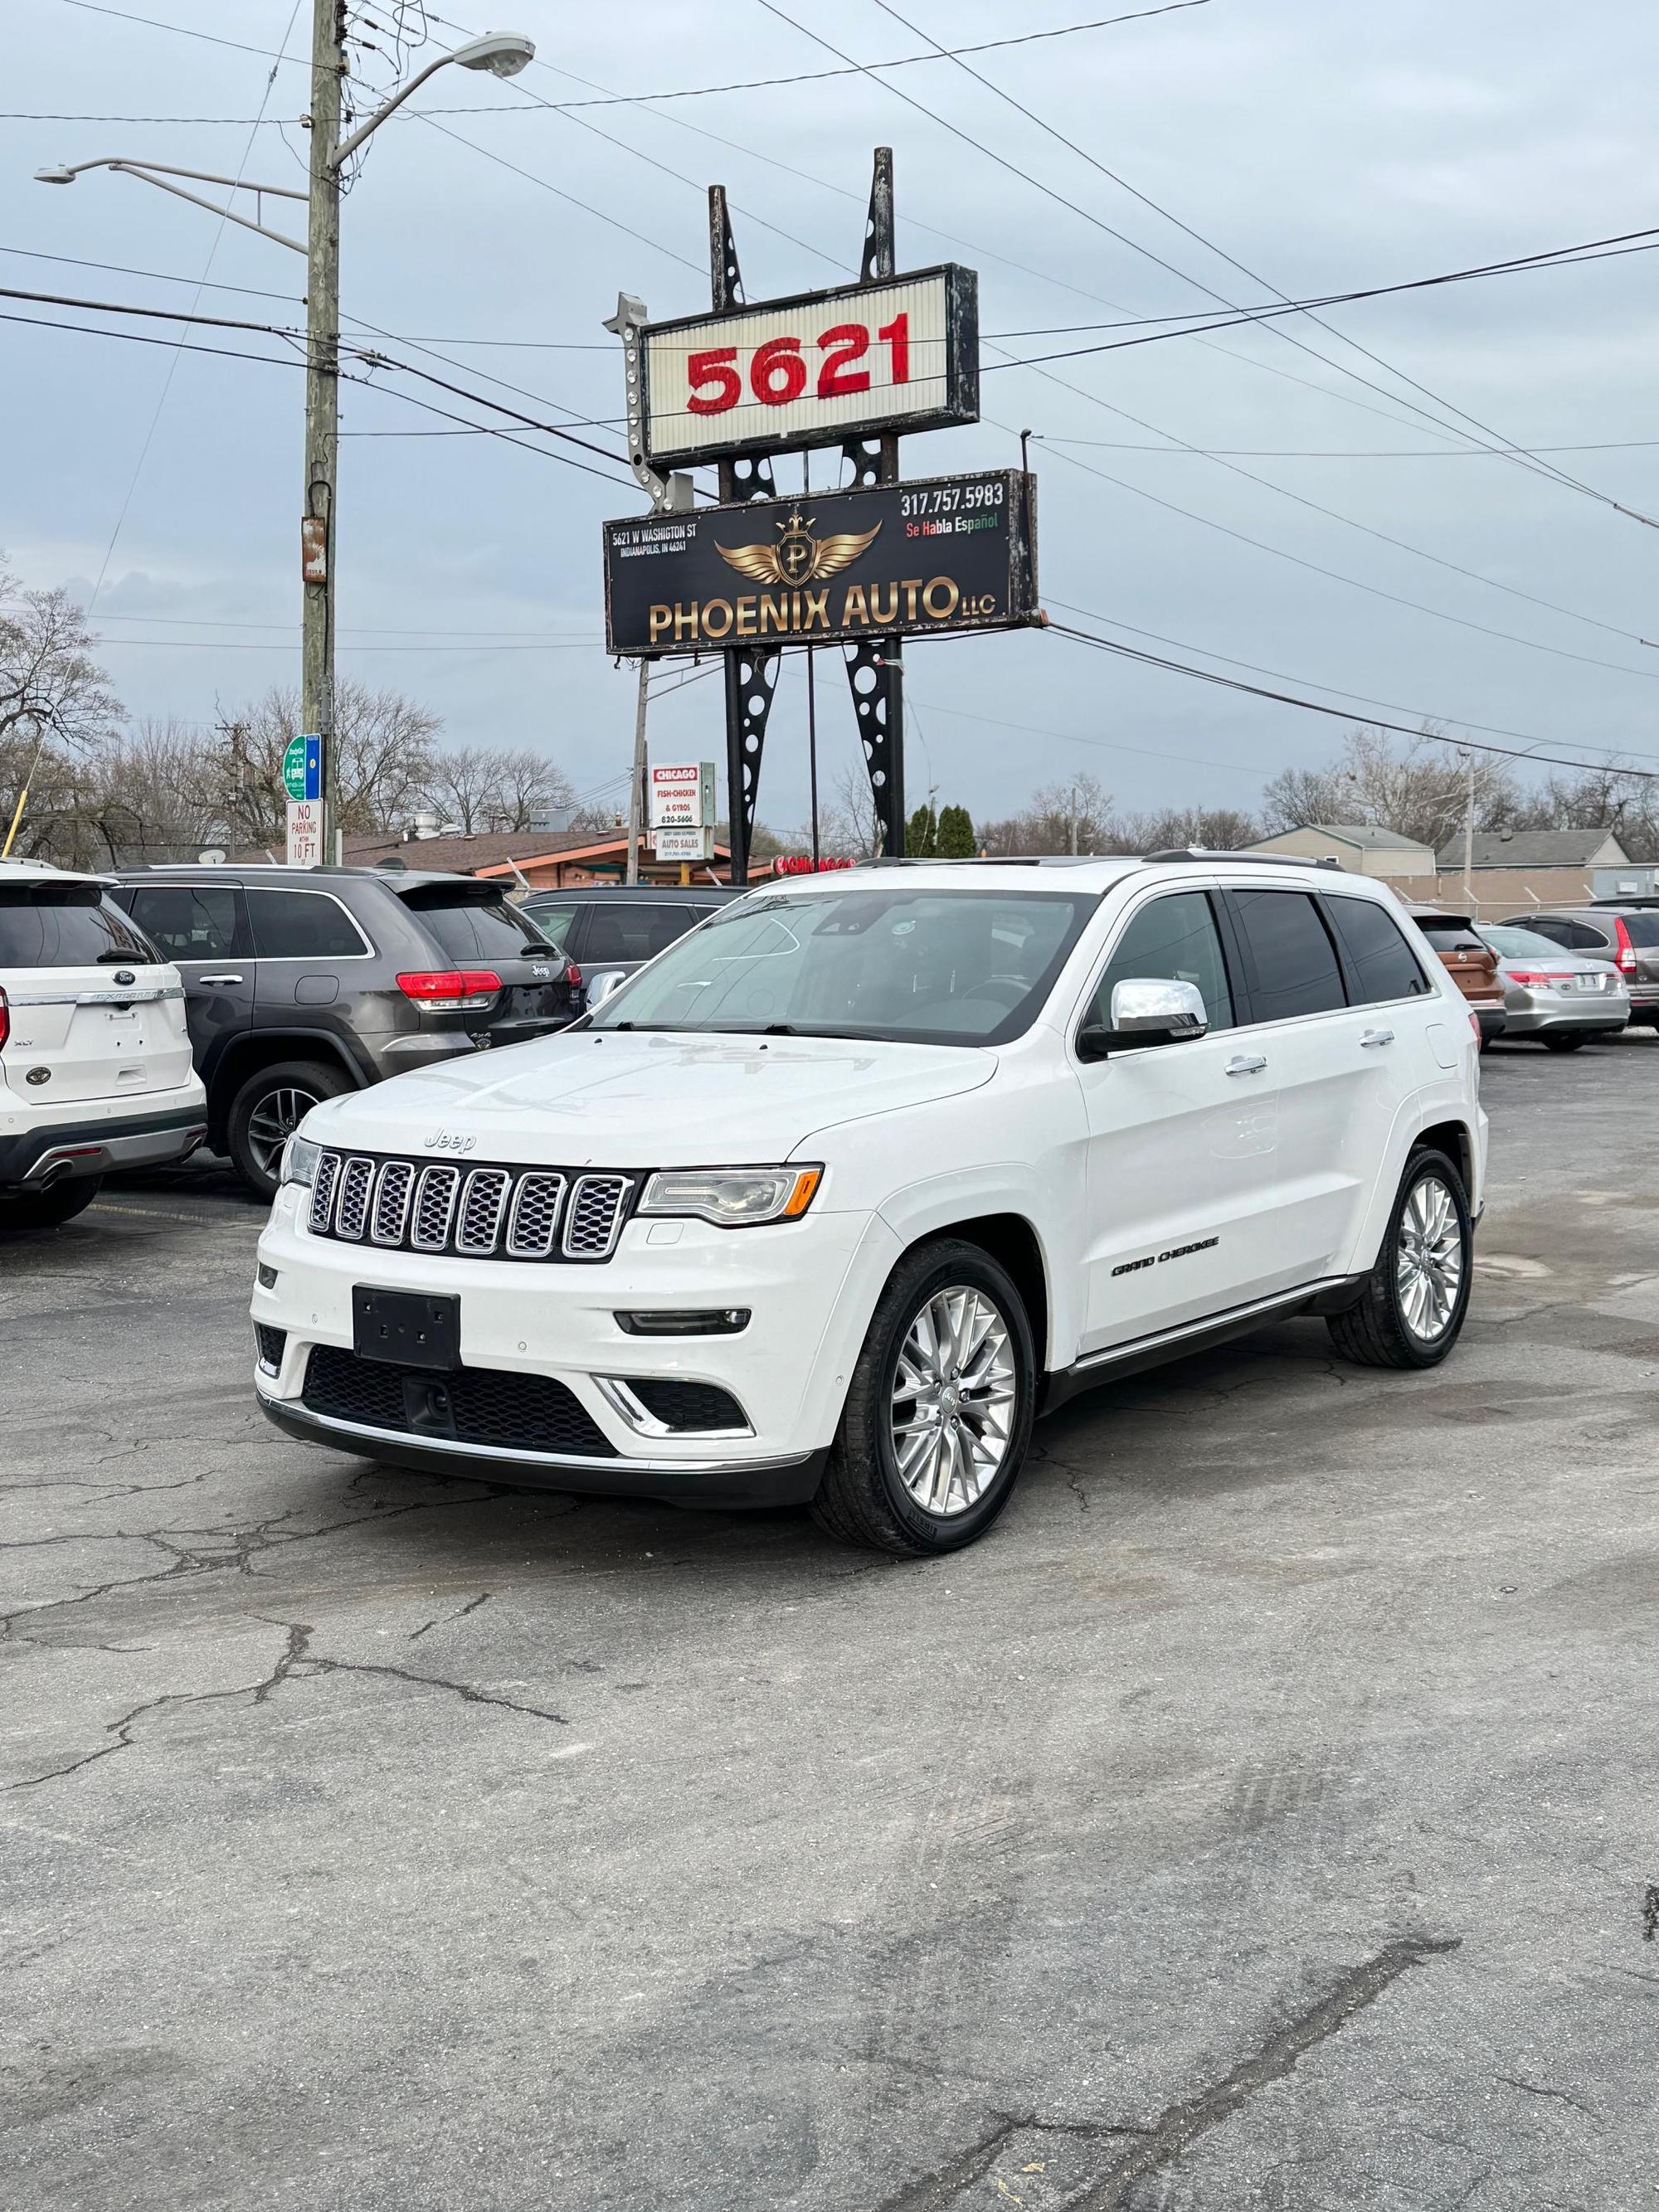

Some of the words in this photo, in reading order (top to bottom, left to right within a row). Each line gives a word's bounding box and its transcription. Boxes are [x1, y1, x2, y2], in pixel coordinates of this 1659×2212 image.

[686, 312, 909, 418] 5621
[901, 483, 1004, 517] 317.757.5983
[907, 523, 919, 537] Se
[922, 518, 952, 536] Habla
[955, 513, 998, 535] Español
[612, 532, 630, 546] 5621
[632, 530, 640, 544] W
[641, 524, 685, 542] WASHIGTON
[687, 523, 697, 537] ST
[662, 542, 669, 553] IN
[669, 541, 686, 552] 46241
[787, 544, 807, 573] P
[649, 588, 830, 643] PHOENIX
[842, 576, 960, 626] AUTO
[962, 593, 996, 616] LLC
[656, 770, 696, 780] CHICAGO
[298, 805, 310, 819] NO
[672, 804, 691, 812] GYROS
[661, 815, 693, 824] 820-5606
[292, 821, 316, 834] PARKING
[294, 844, 302, 858] 10
[304, 843, 316, 858] FT
[662, 839, 679, 848] AUTO
[680, 839, 698, 848] SALES
[119, 972, 132, 982] Ford
[532, 965, 550, 977] Jeep
[424, 1127, 477, 1155] Jeep
[1111, 1256, 1155, 1277] GRAND
[1158, 1236, 1220, 1262] CHEROKEE
